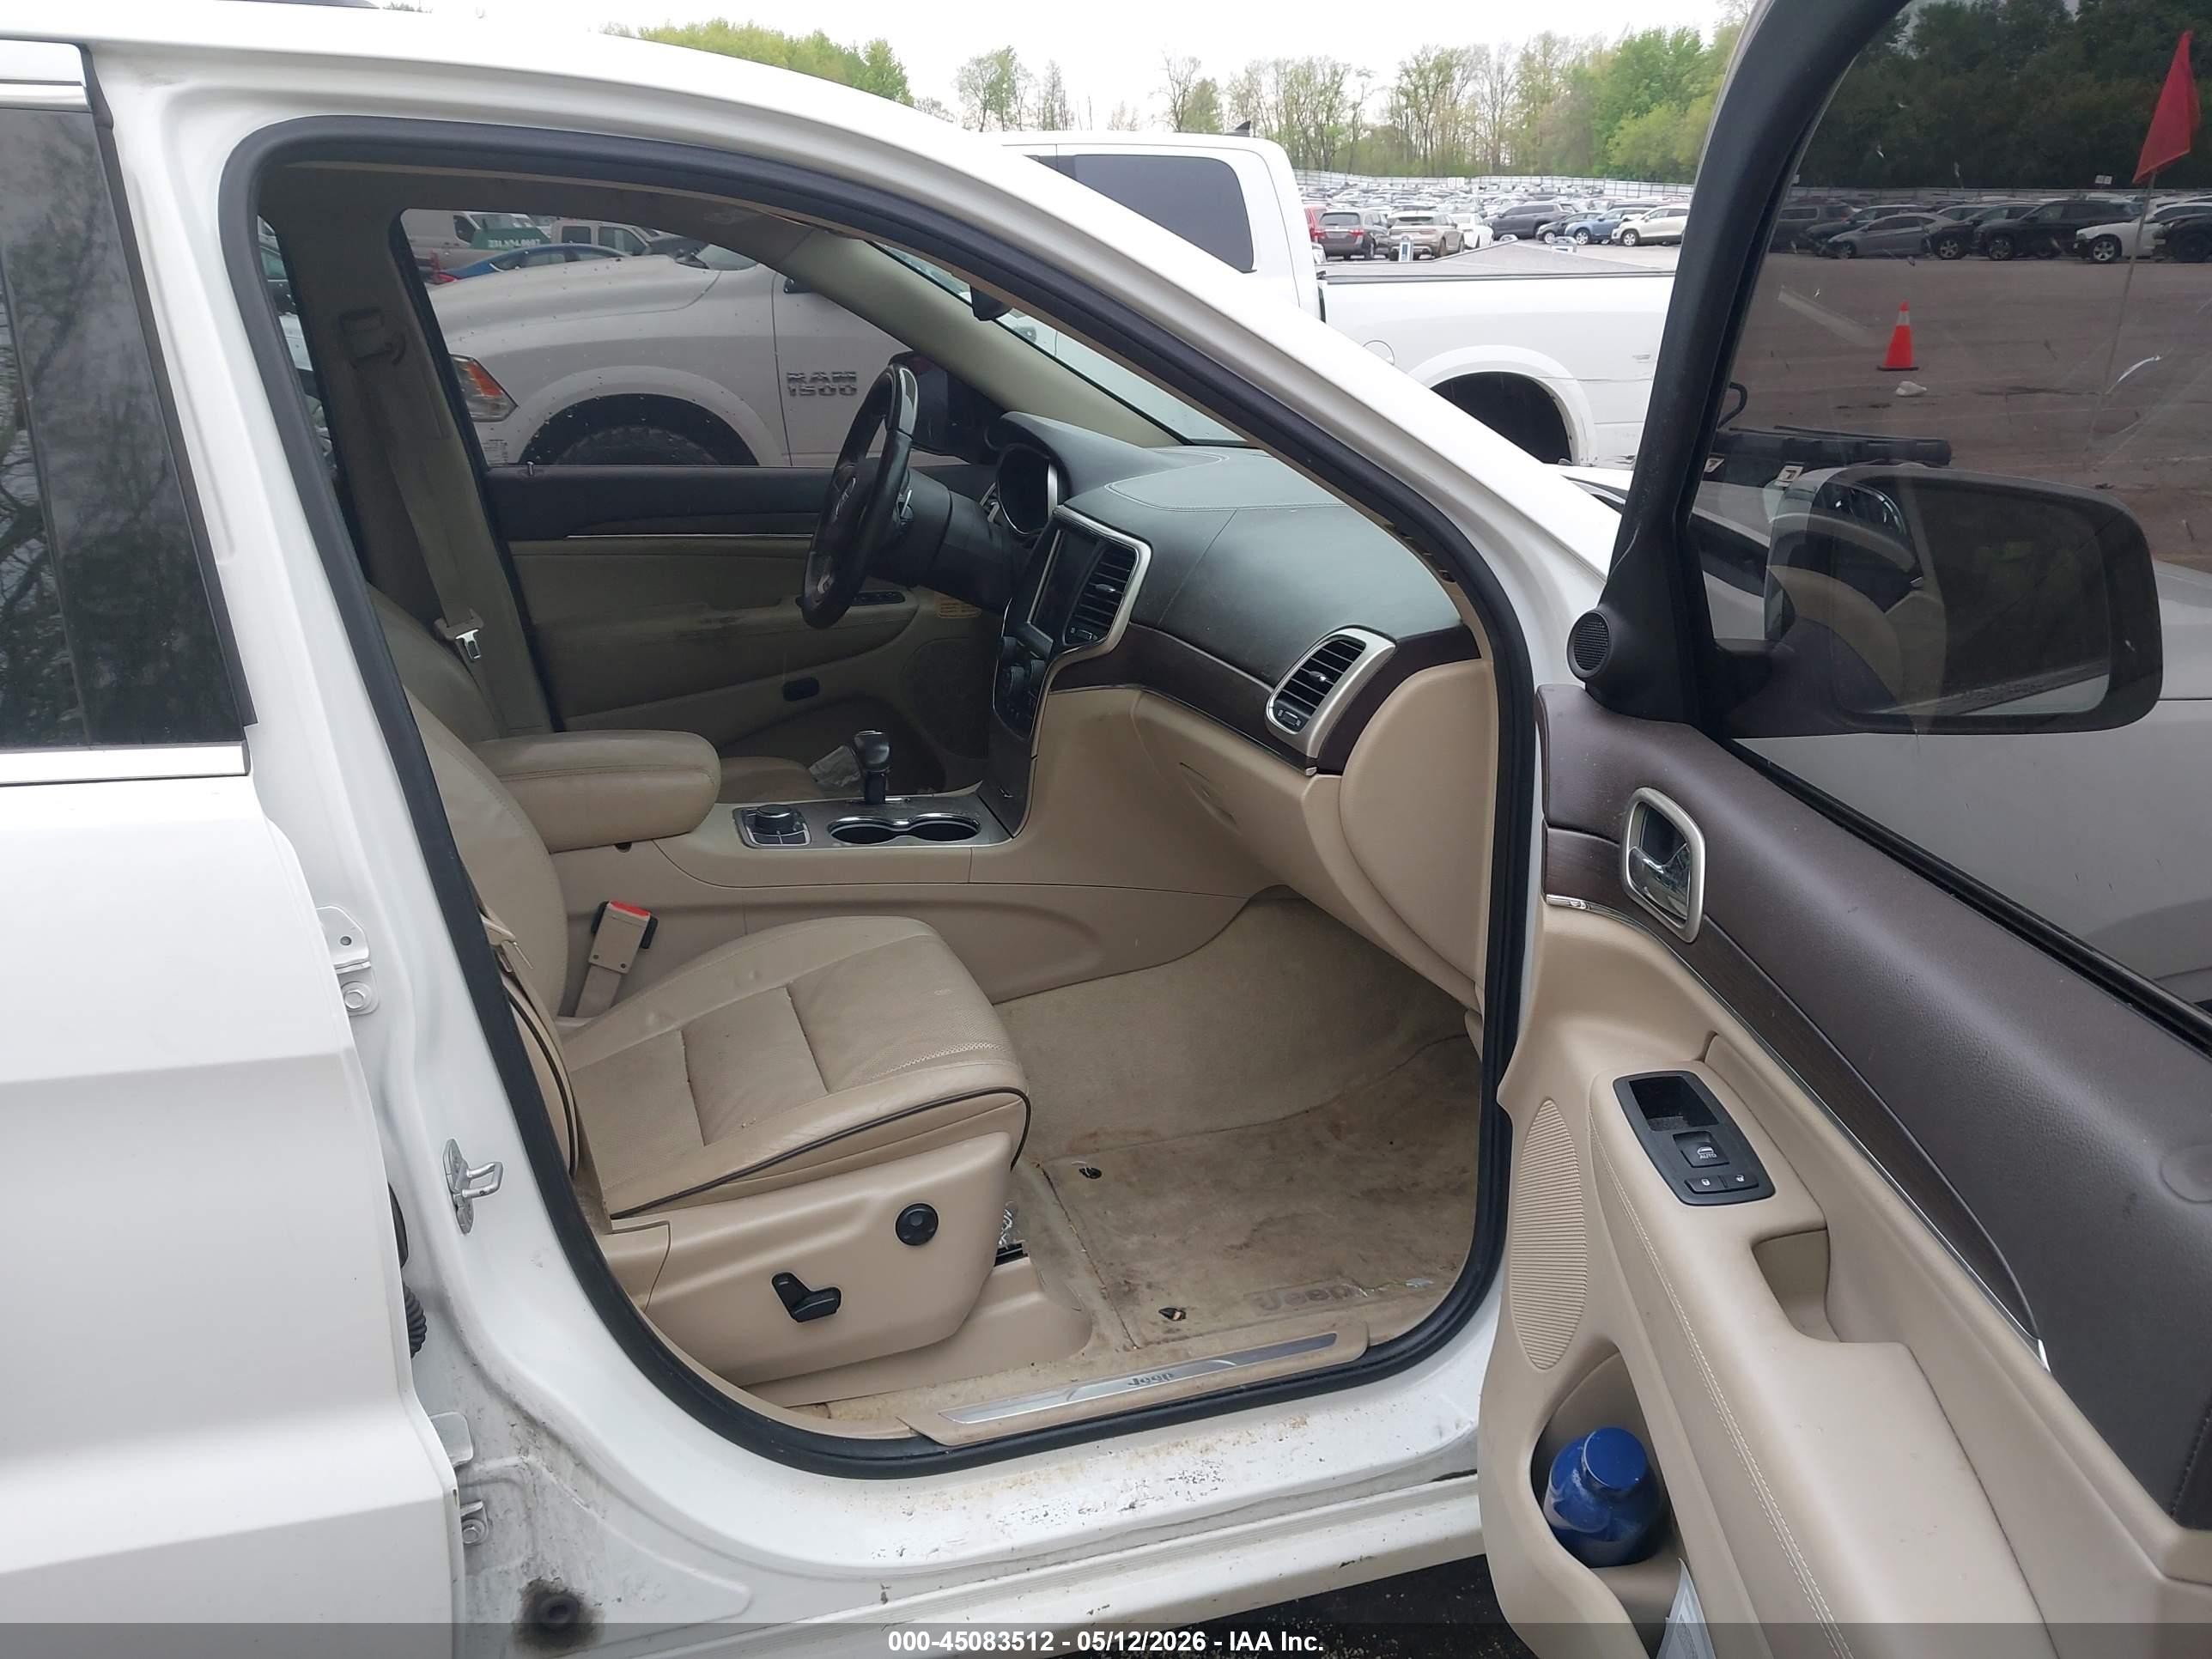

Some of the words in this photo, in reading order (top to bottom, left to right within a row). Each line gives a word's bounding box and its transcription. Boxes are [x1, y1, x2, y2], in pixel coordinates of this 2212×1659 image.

[787, 371, 857, 384] RAM
[787, 384, 858, 396] 1500
[1127, 1373, 1174, 1386] Jeep
